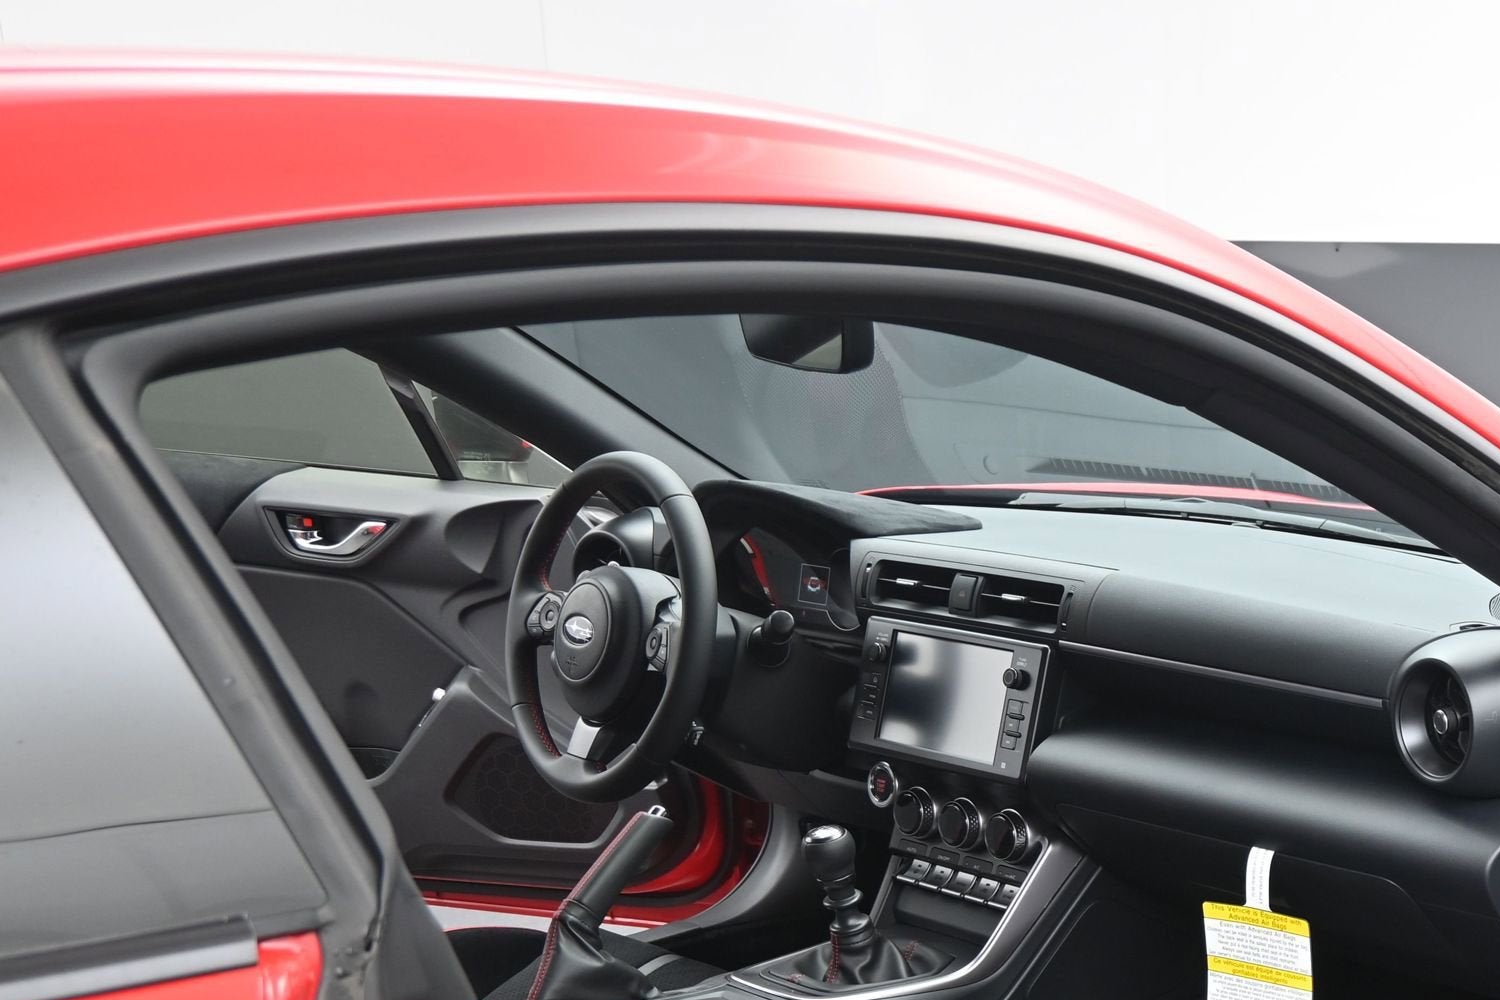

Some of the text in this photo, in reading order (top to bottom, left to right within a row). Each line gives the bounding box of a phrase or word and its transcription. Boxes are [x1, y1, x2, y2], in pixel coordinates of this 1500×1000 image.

[1227, 906, 1251, 916] Vehicle
[1229, 913, 1259, 924] Advanced
[1272, 921, 1287, 931] Bags
